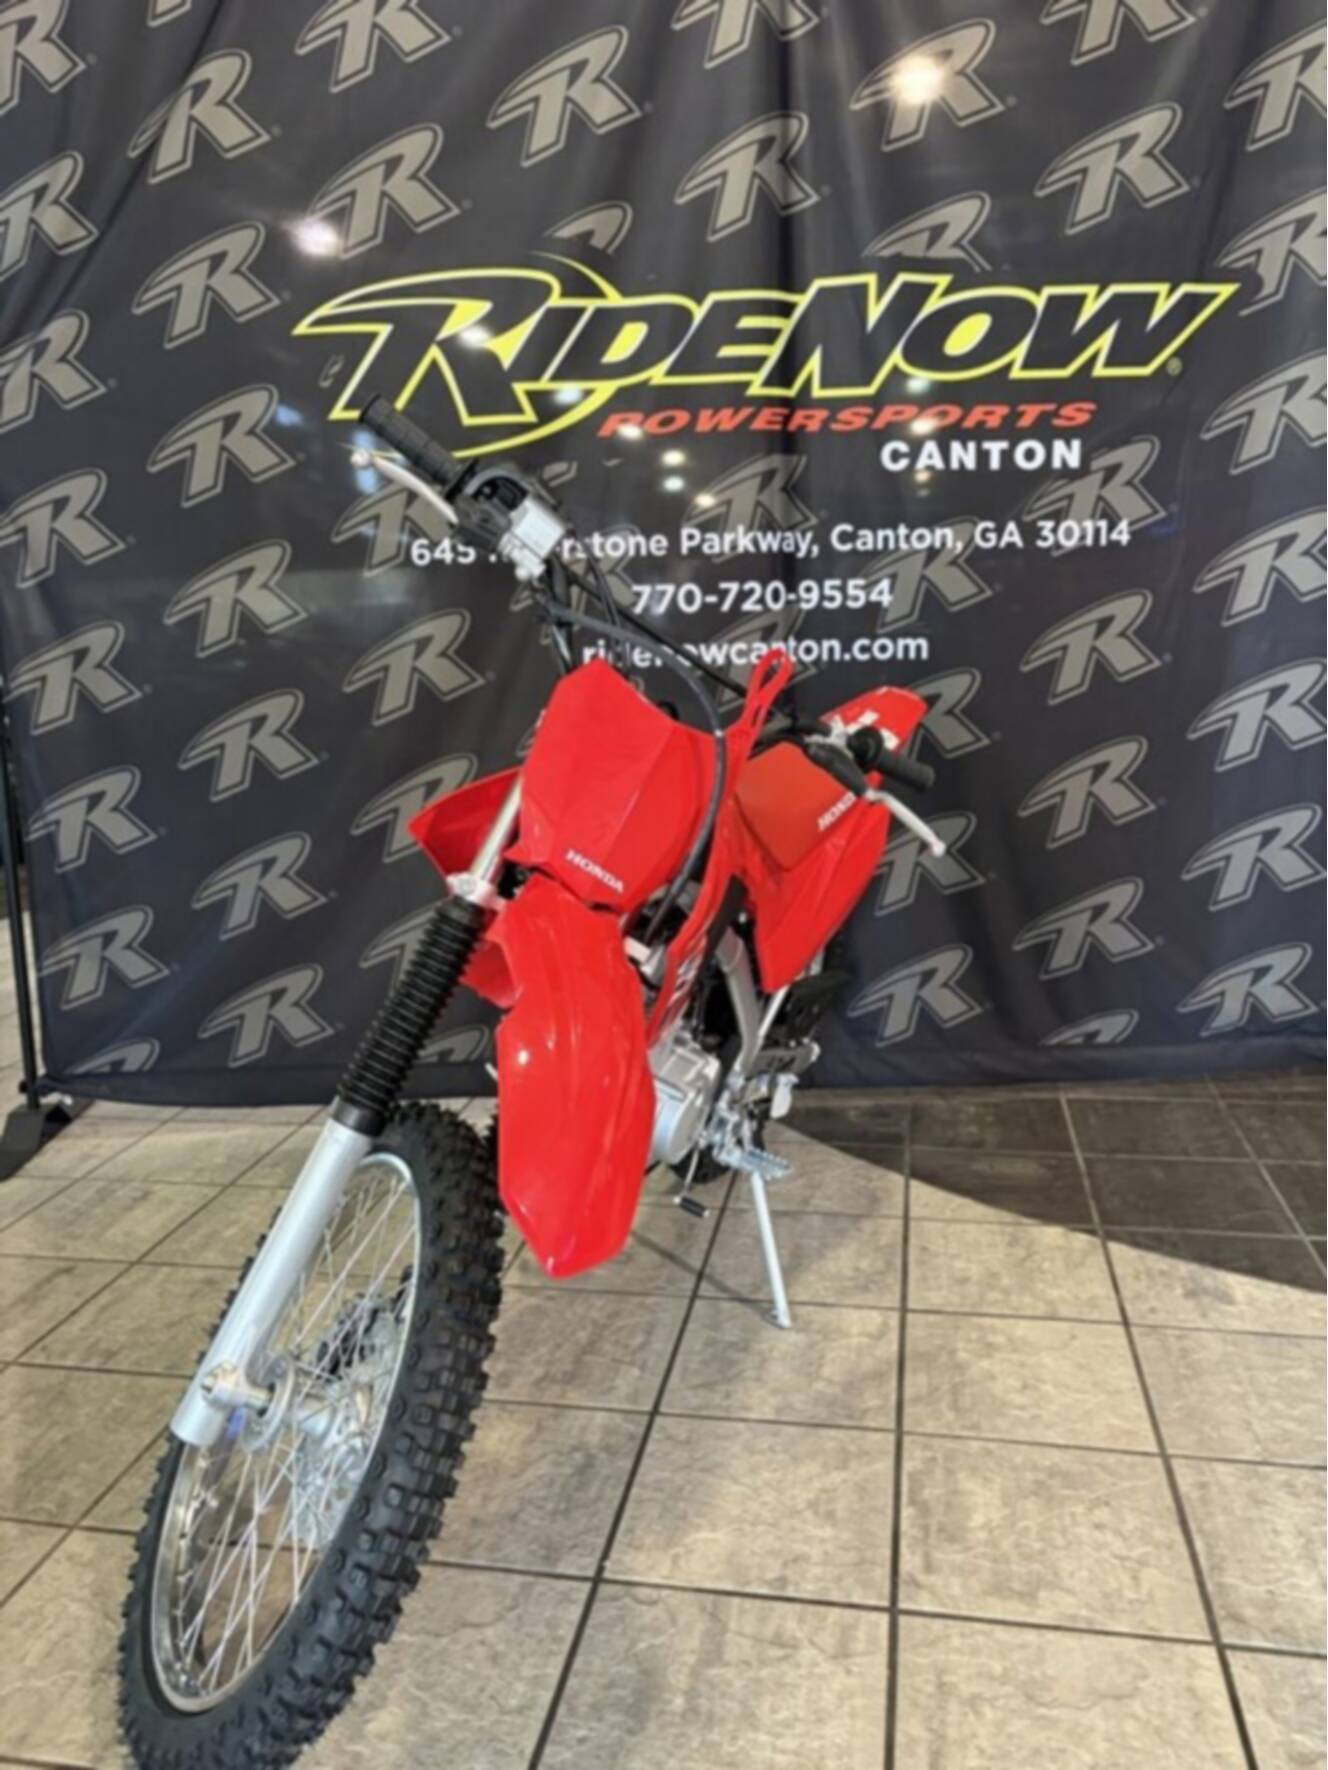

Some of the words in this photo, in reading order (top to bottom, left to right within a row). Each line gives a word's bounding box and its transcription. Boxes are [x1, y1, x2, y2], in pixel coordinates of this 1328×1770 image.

[598, 403, 1097, 437] POWERSPORTS
[880, 439, 1082, 471] CANTON
[411, 537, 476, 567] 645
[680, 524, 819, 558] Parkway,
[830, 522, 964, 554] Canton,
[974, 520, 1023, 548] GA
[1036, 519, 1131, 547] 30114
[632, 578, 894, 615] 770-720-9554
[583, 636, 929, 668] rieowcaton.com
[566, 848, 624, 893] HONDA
